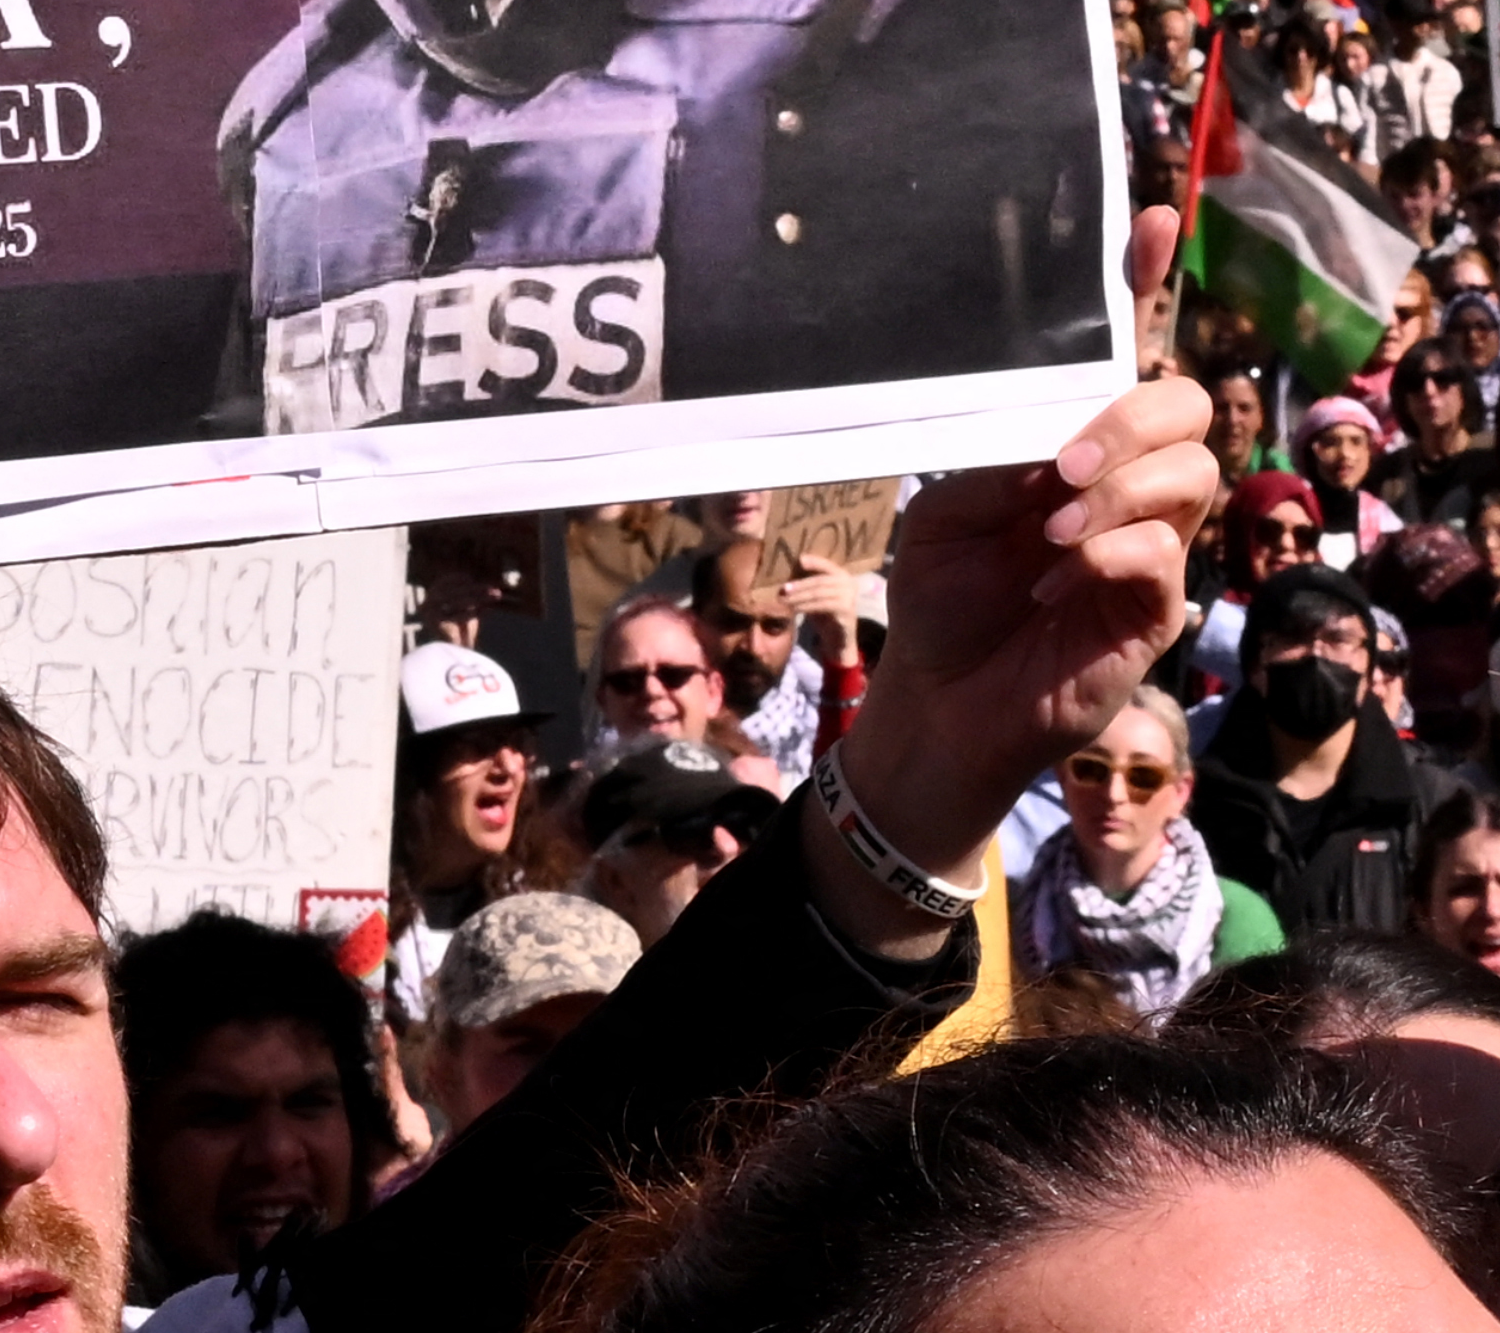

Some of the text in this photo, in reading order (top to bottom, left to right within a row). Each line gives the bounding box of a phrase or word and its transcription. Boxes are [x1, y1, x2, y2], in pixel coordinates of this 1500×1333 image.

[280, 274, 647, 415] PRESS
[771, 516, 878, 575] NOW
[30, 661, 376, 768] ENOCIDE
[103, 767, 339, 864] RVIVORS
[816, 757, 842, 814] AZA
[887, 867, 958, 919] FREE
